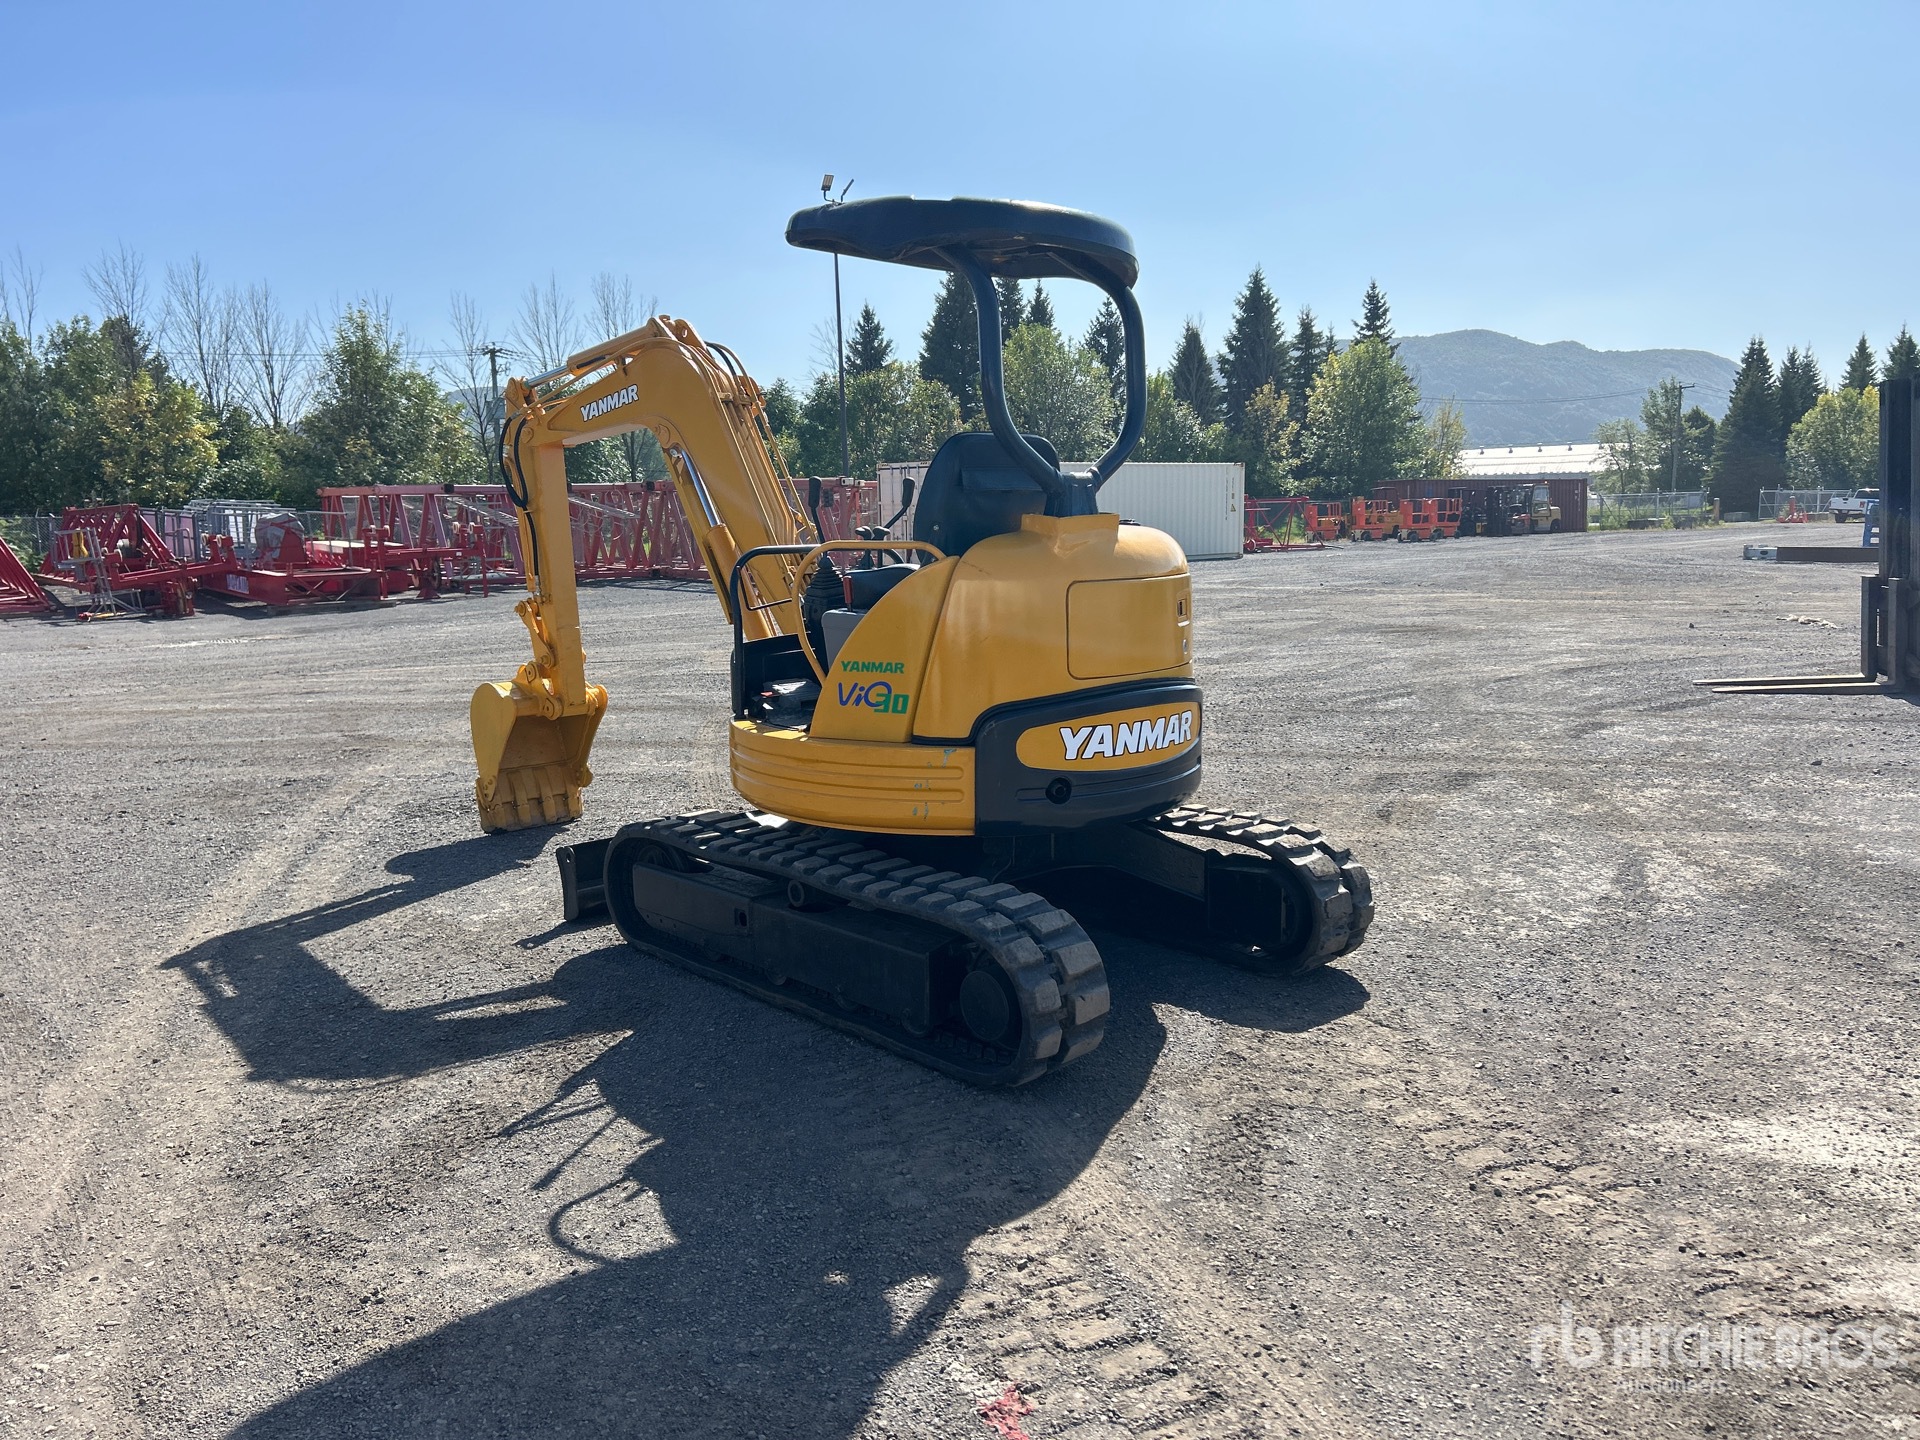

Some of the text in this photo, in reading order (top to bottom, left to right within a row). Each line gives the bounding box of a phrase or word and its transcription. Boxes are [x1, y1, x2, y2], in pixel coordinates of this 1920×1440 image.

[580, 384, 639, 422] YANMAR
[840, 660, 905, 674] YANMAR
[1059, 710, 1193, 761] YANMAR
